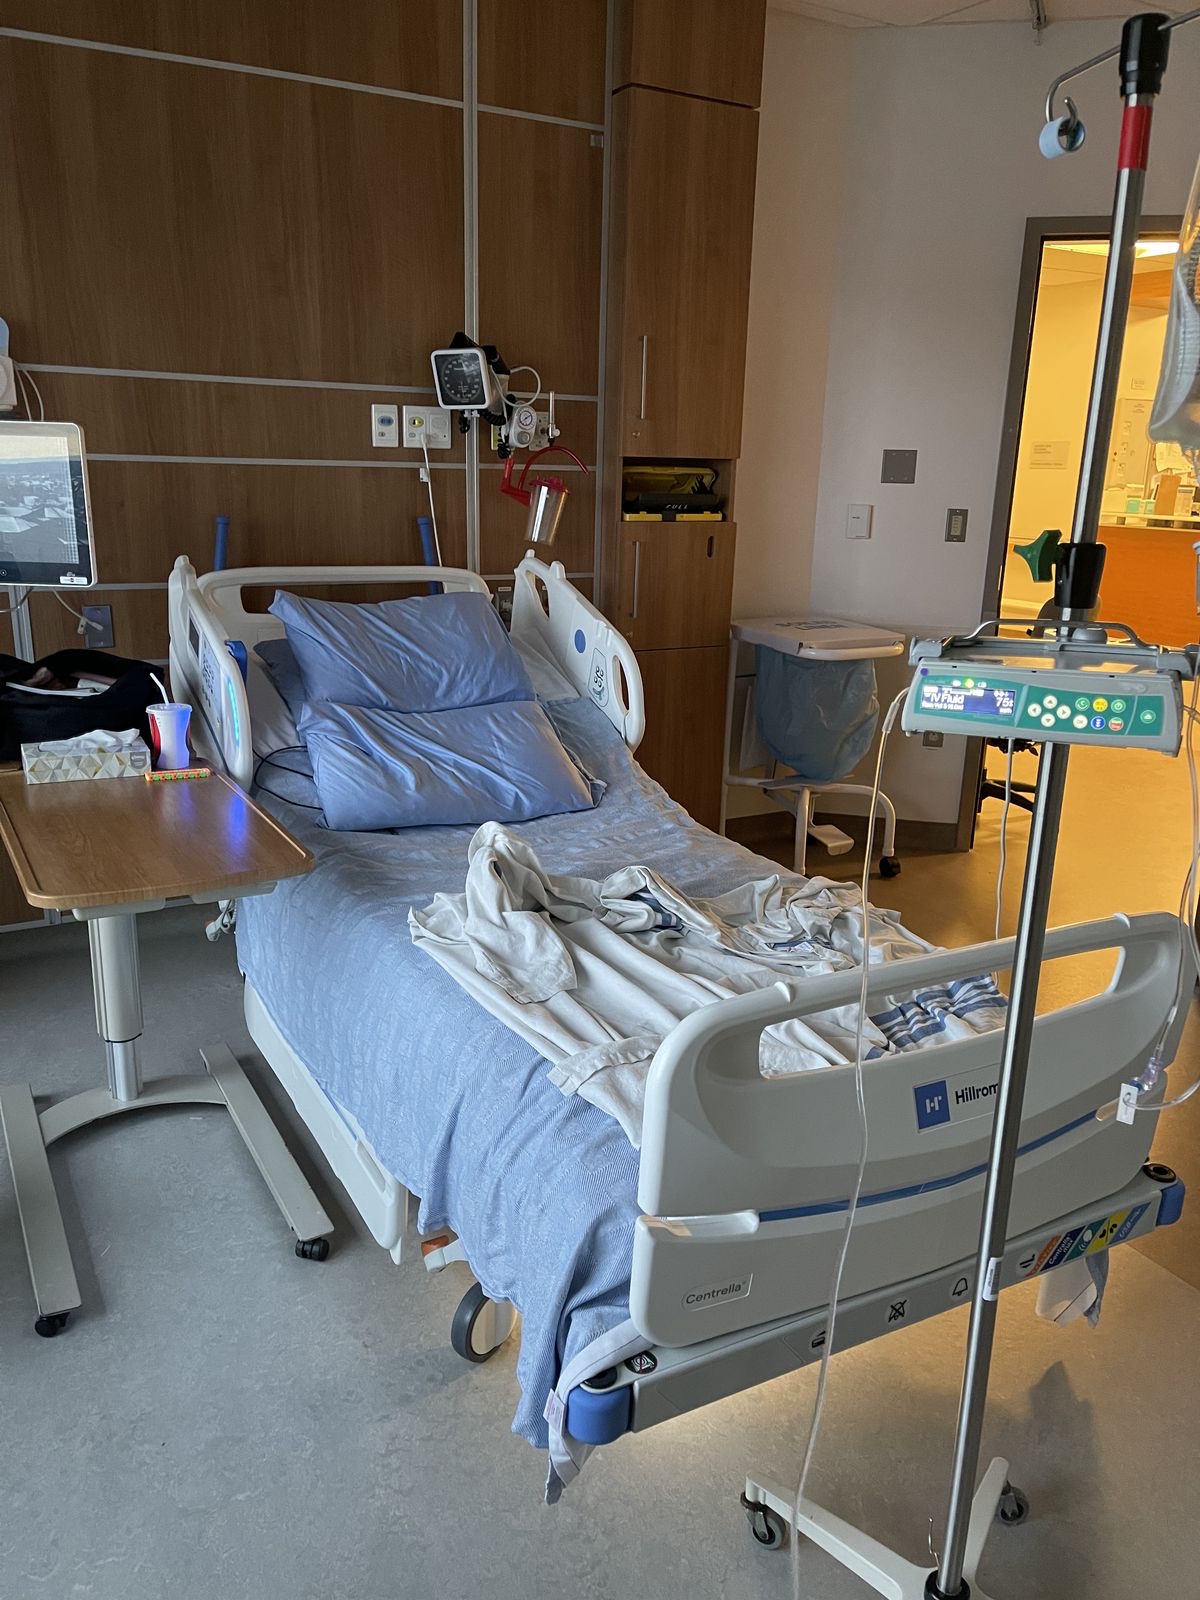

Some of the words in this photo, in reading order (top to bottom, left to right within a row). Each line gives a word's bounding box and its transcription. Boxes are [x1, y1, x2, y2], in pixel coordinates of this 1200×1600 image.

[942, 693, 965, 704] Fluid
[955, 1082, 999, 1105] Hillrom
[685, 1283, 742, 1304] Centrella
